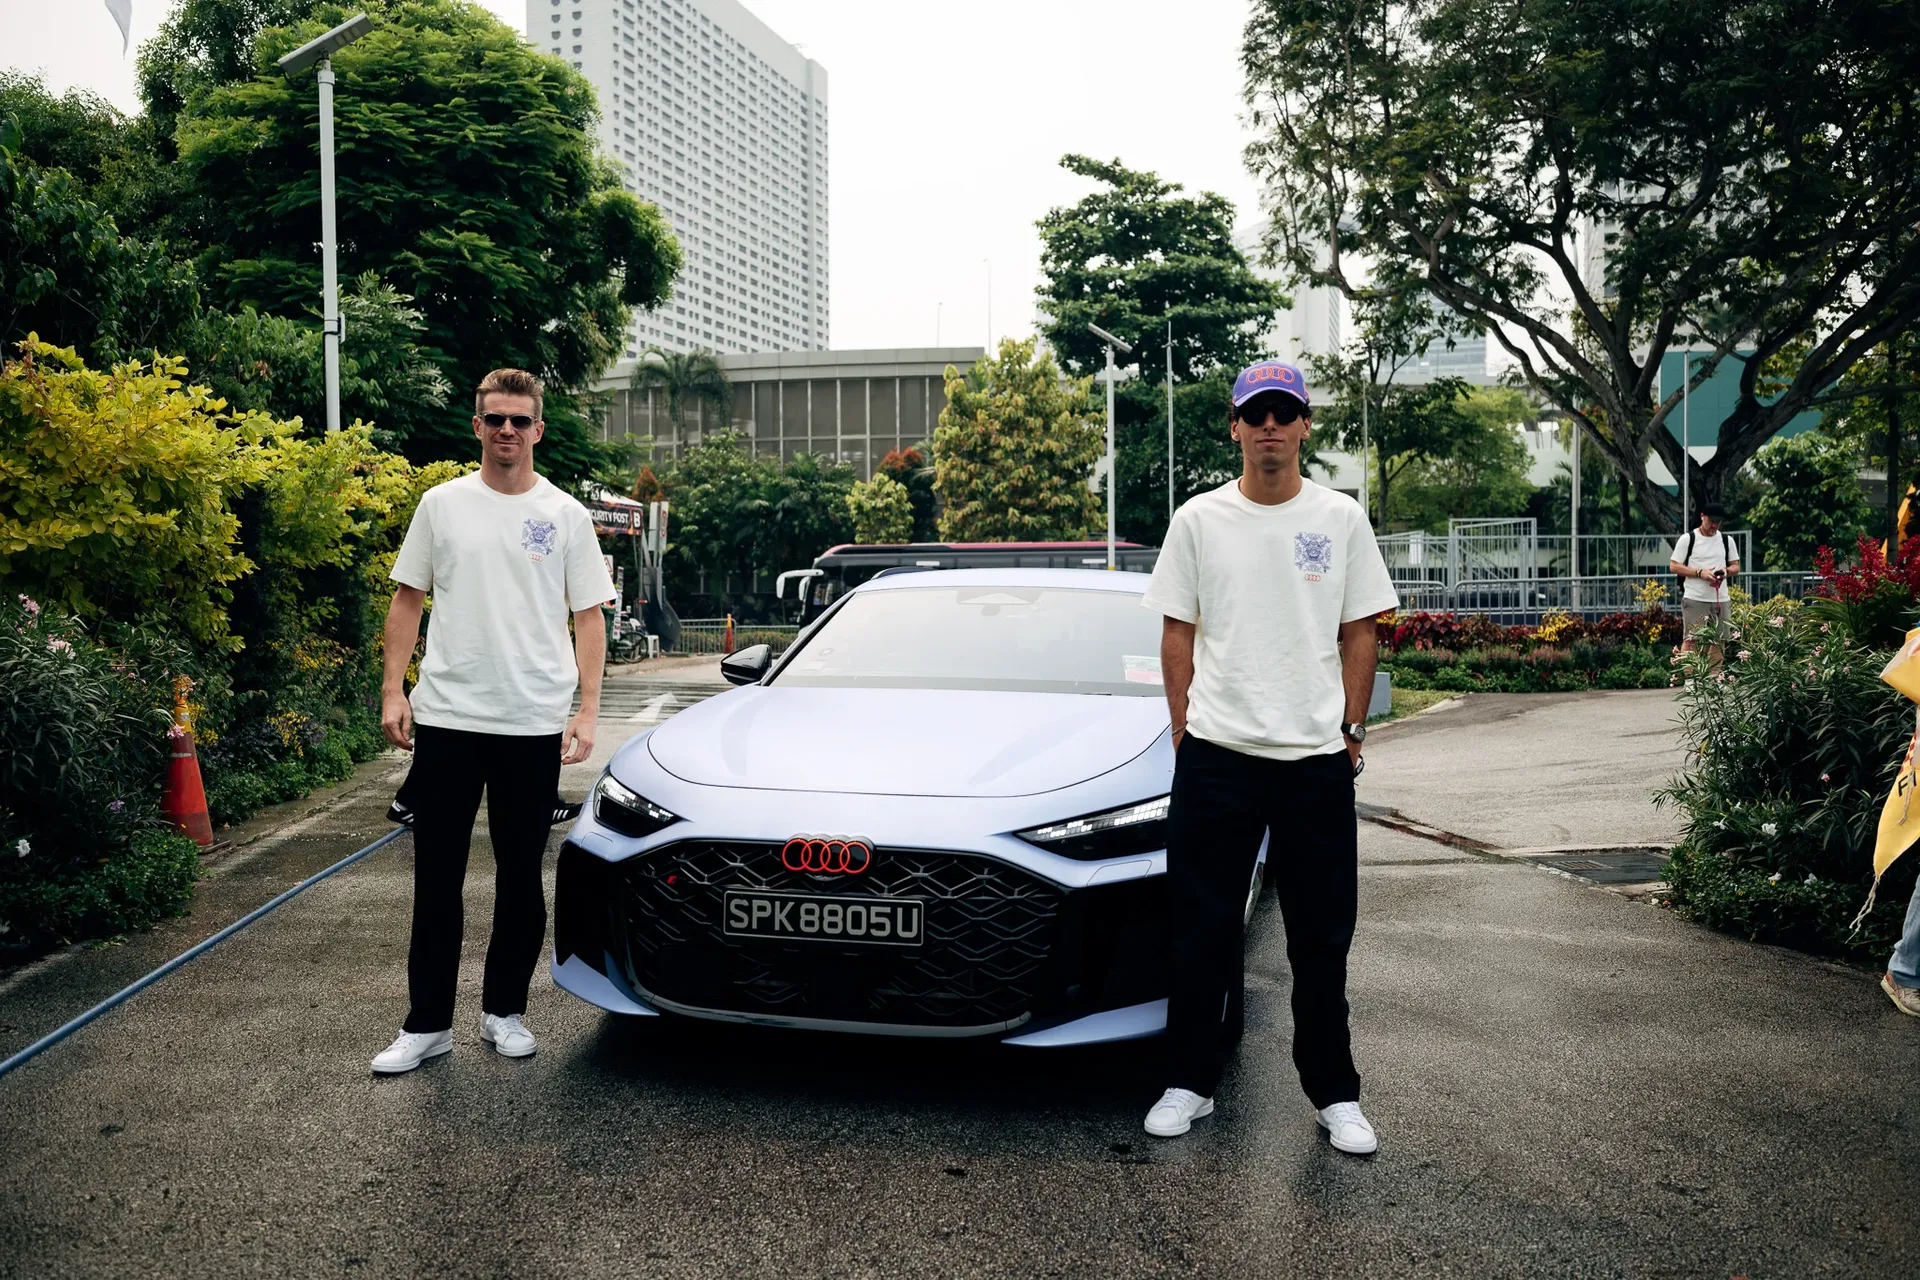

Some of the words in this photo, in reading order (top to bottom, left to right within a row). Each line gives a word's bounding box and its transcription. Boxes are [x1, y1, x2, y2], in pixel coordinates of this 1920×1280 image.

[589, 509, 612, 522] CURITY
[613, 512, 629, 524] POST
[633, 512, 641, 528] B
[729, 898, 918, 938] SPK8805U
